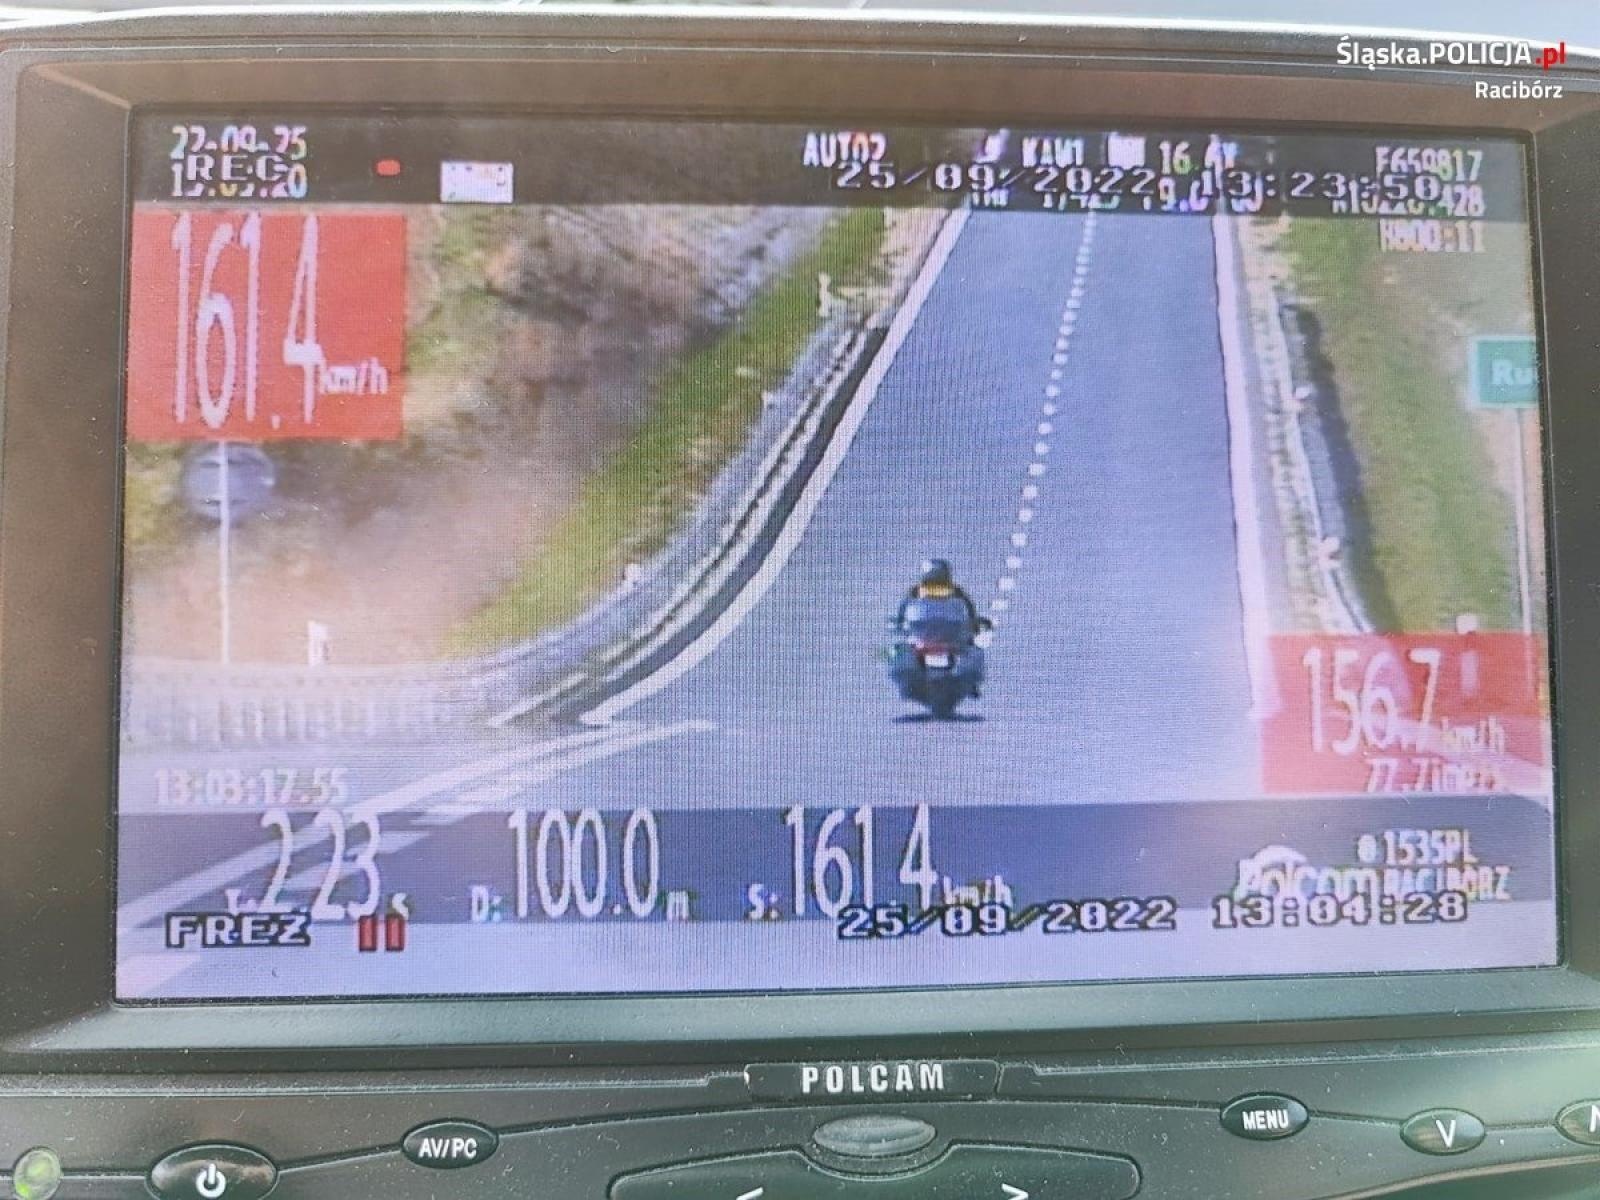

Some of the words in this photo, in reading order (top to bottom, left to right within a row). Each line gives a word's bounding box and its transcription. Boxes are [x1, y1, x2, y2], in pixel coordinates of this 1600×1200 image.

[170, 210, 323, 430] 161.4
[509, 808, 660, 918] 100.0
[838, 899, 1177, 938] 25/09/2022
[1213, 892, 1467, 928] 13:04:28
[802, 1064, 944, 1093] POLCAM
[1242, 1108, 1289, 1130] MENU
[419, 1138, 477, 1161] AV/PC
